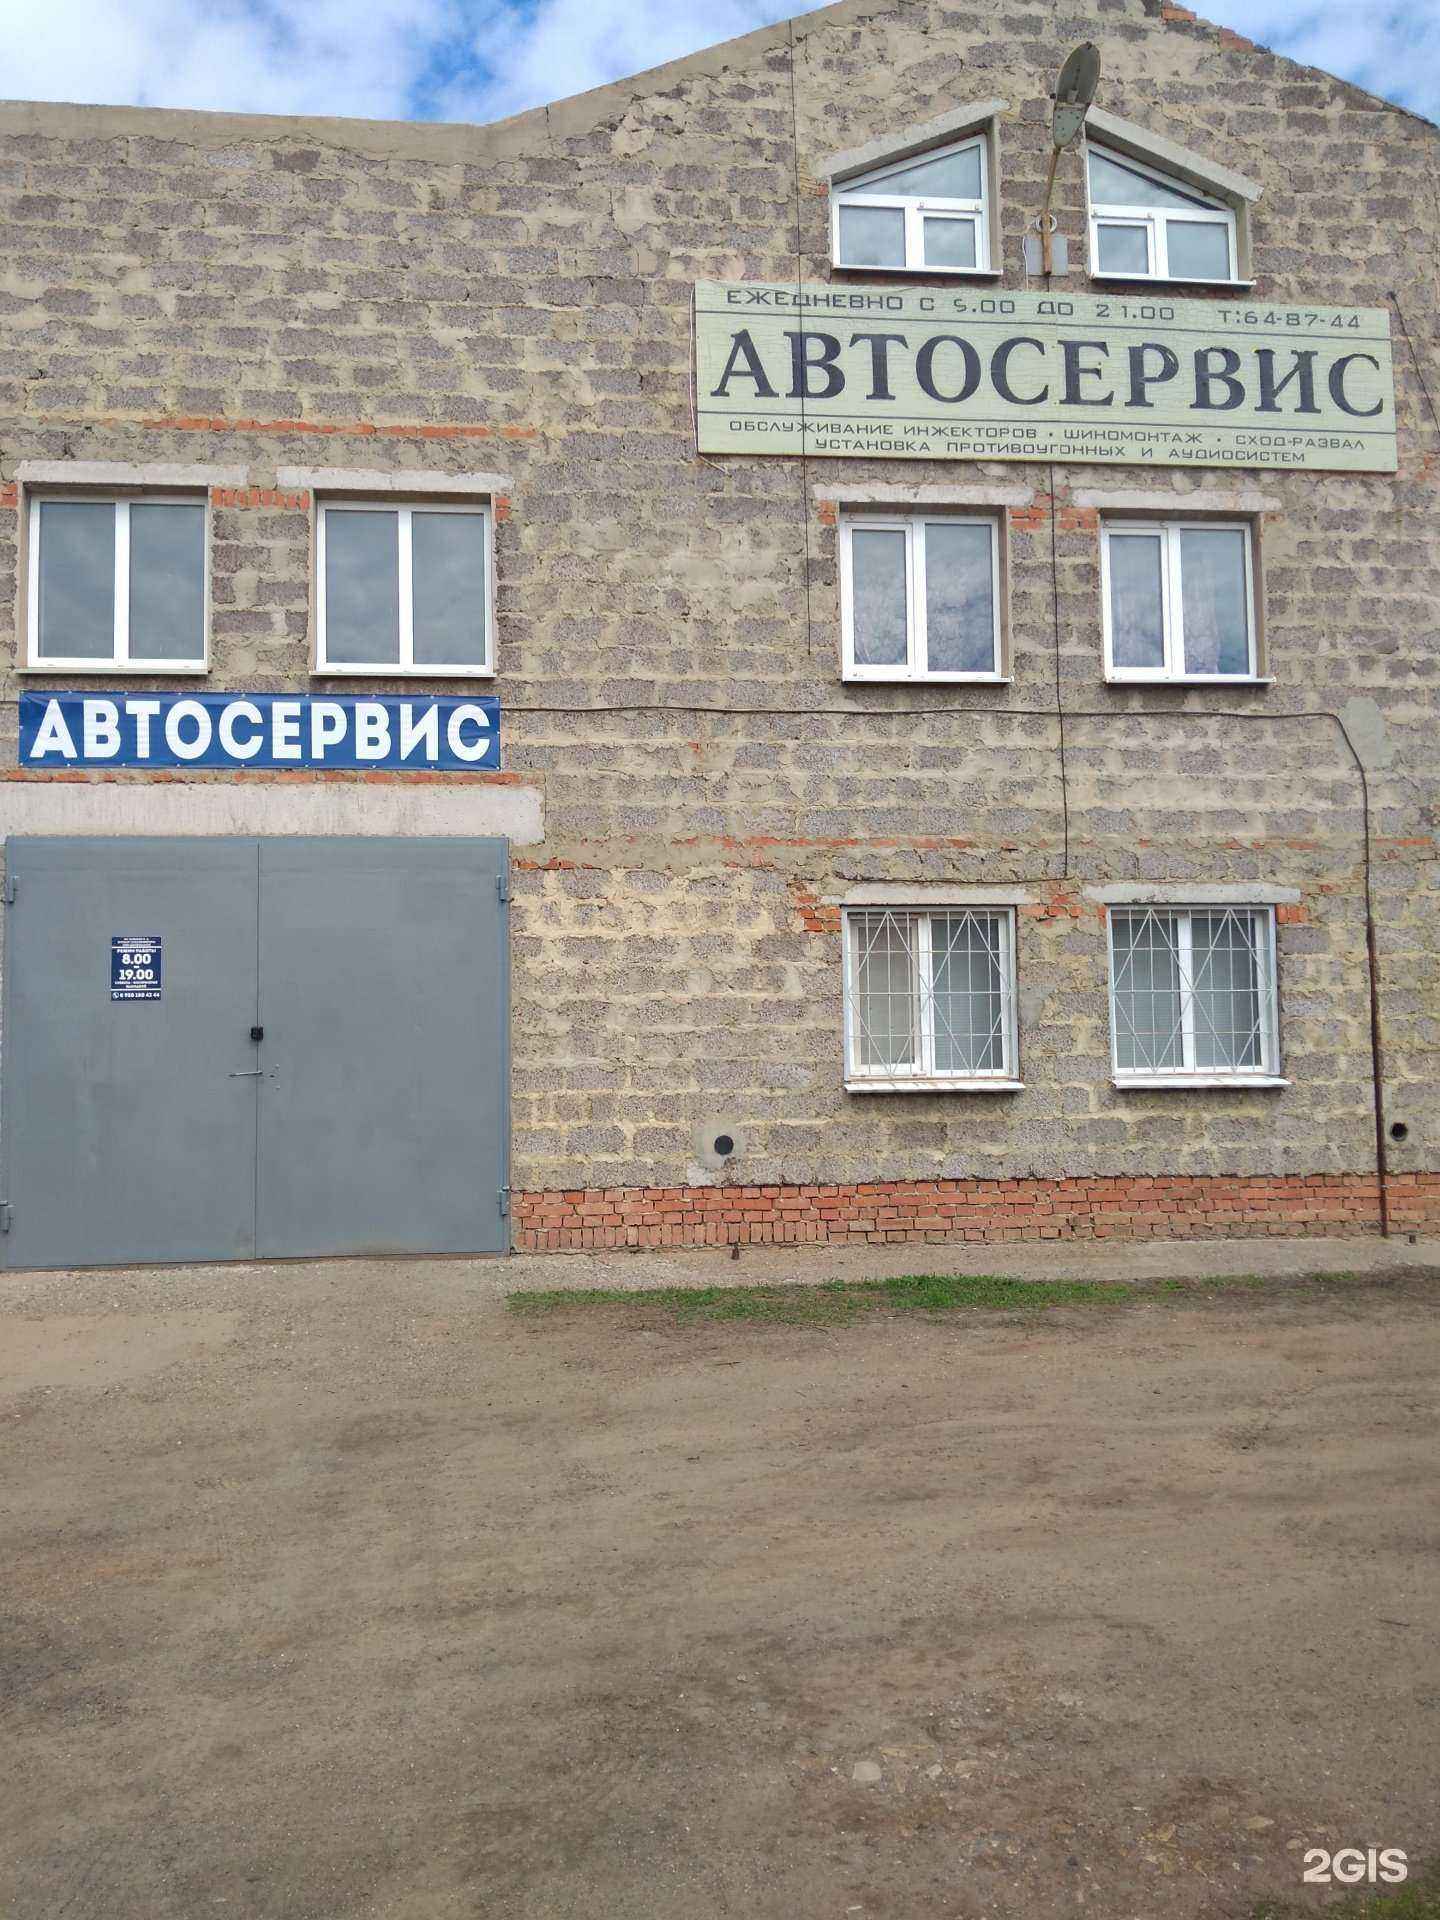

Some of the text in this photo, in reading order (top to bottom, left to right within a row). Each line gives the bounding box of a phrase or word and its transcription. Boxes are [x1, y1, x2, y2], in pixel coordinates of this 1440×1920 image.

[726, 289, 904, 311] ЕЖЕДНЕВНО
[919, 297, 935, 311] С
[1036, 300, 1075, 316] ДО
[1095, 303, 1176, 320] 21.00
[709, 328, 1385, 417] АВТОСЕРВИС
[729, 420, 1366, 450] ОБСЛУЖИВАНИЕ ИНЖЕКТОРОВ ШИНОМОНТАЖ СХОД-РАЗВАЛ
[815, 438, 1306, 463] УСТАНОВКА ПРОТИВОУГОННЫХ И АУДИОСИСТЕМ
[29, 698, 492, 762] АВТОСЕРВИС
[121, 953, 152, 965] 8.00
[118, 968, 154, 981] 19.00
